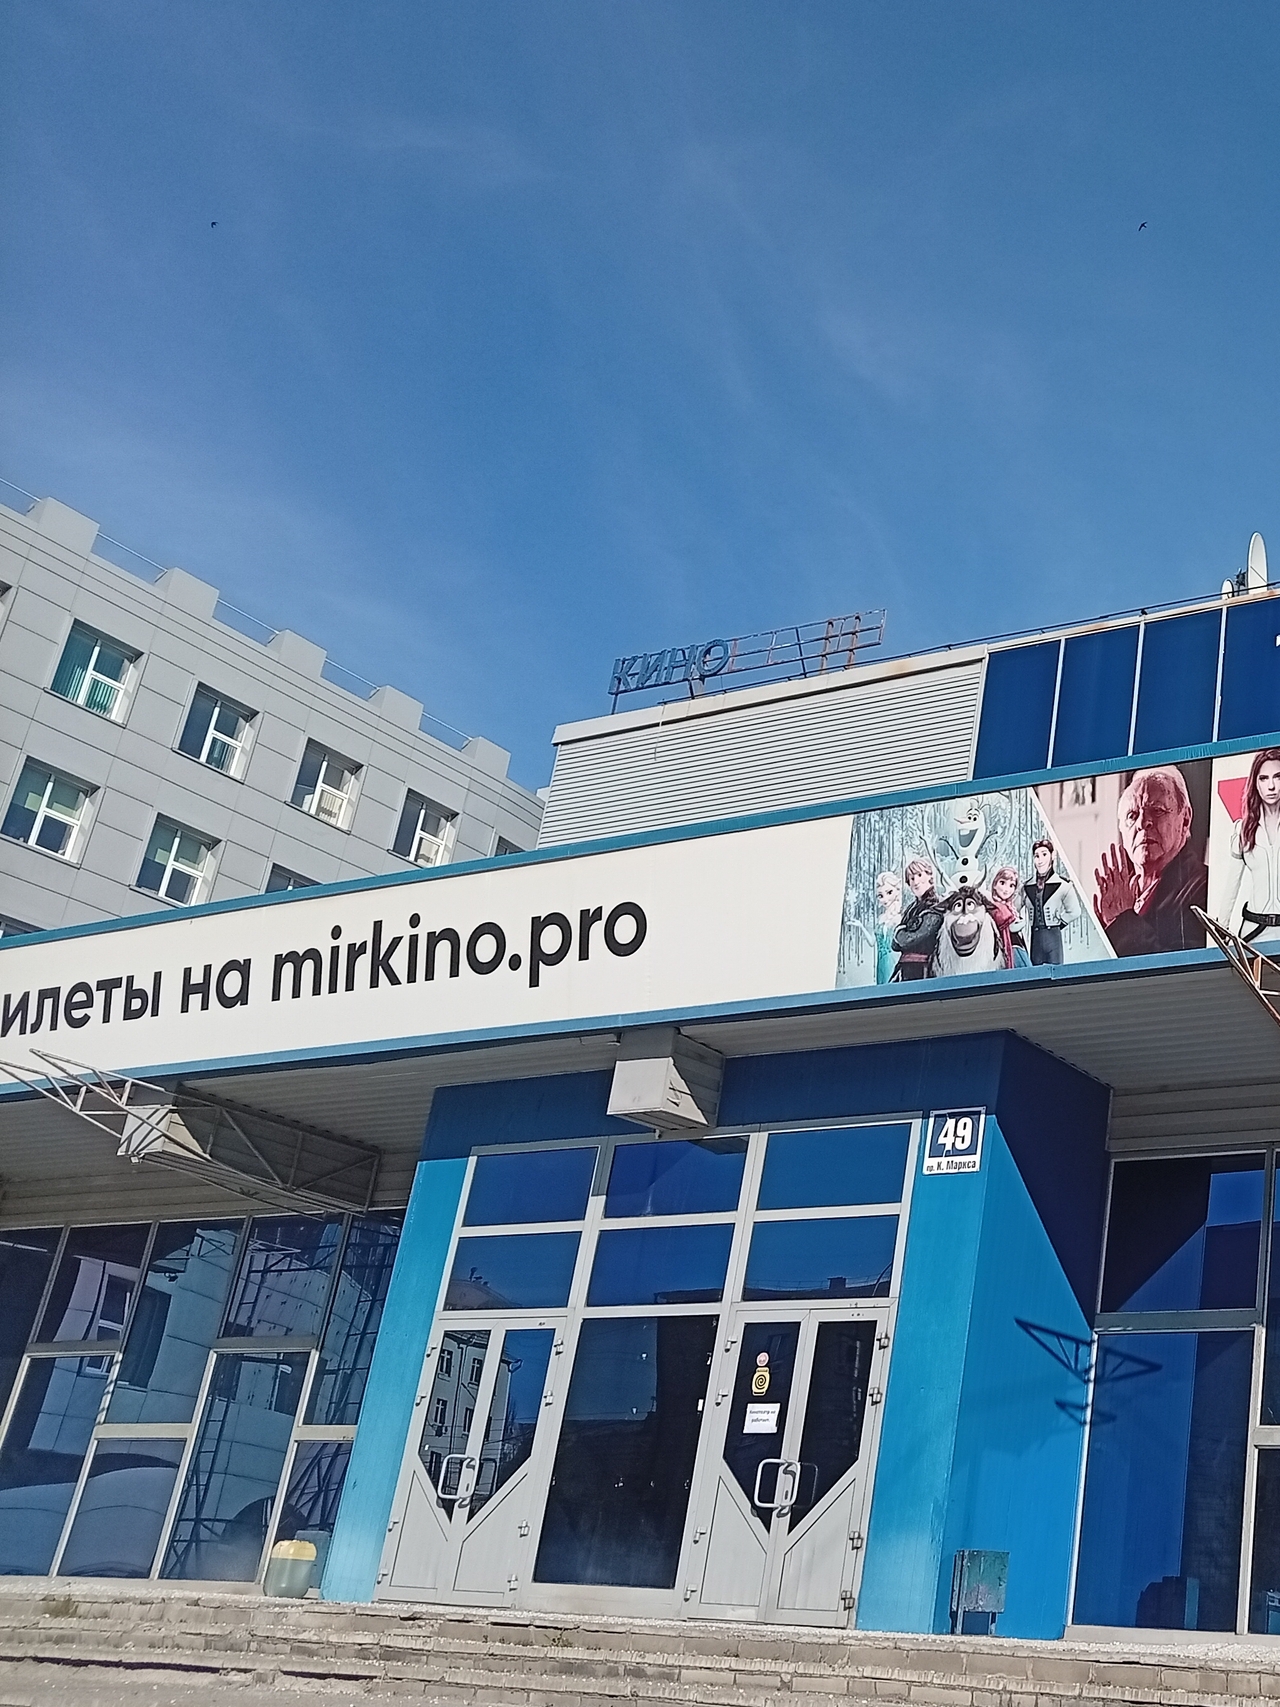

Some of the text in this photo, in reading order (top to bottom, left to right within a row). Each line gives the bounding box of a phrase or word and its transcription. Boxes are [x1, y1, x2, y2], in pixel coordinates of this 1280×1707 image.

[607, 637, 731, 695] КИНО
[180, 956, 252, 1014] на
[271, 900, 648, 1002] mirkino.pro
[937, 1115, 974, 1151] 49
[926, 1160, 977, 1173] пр. К. Маркса
